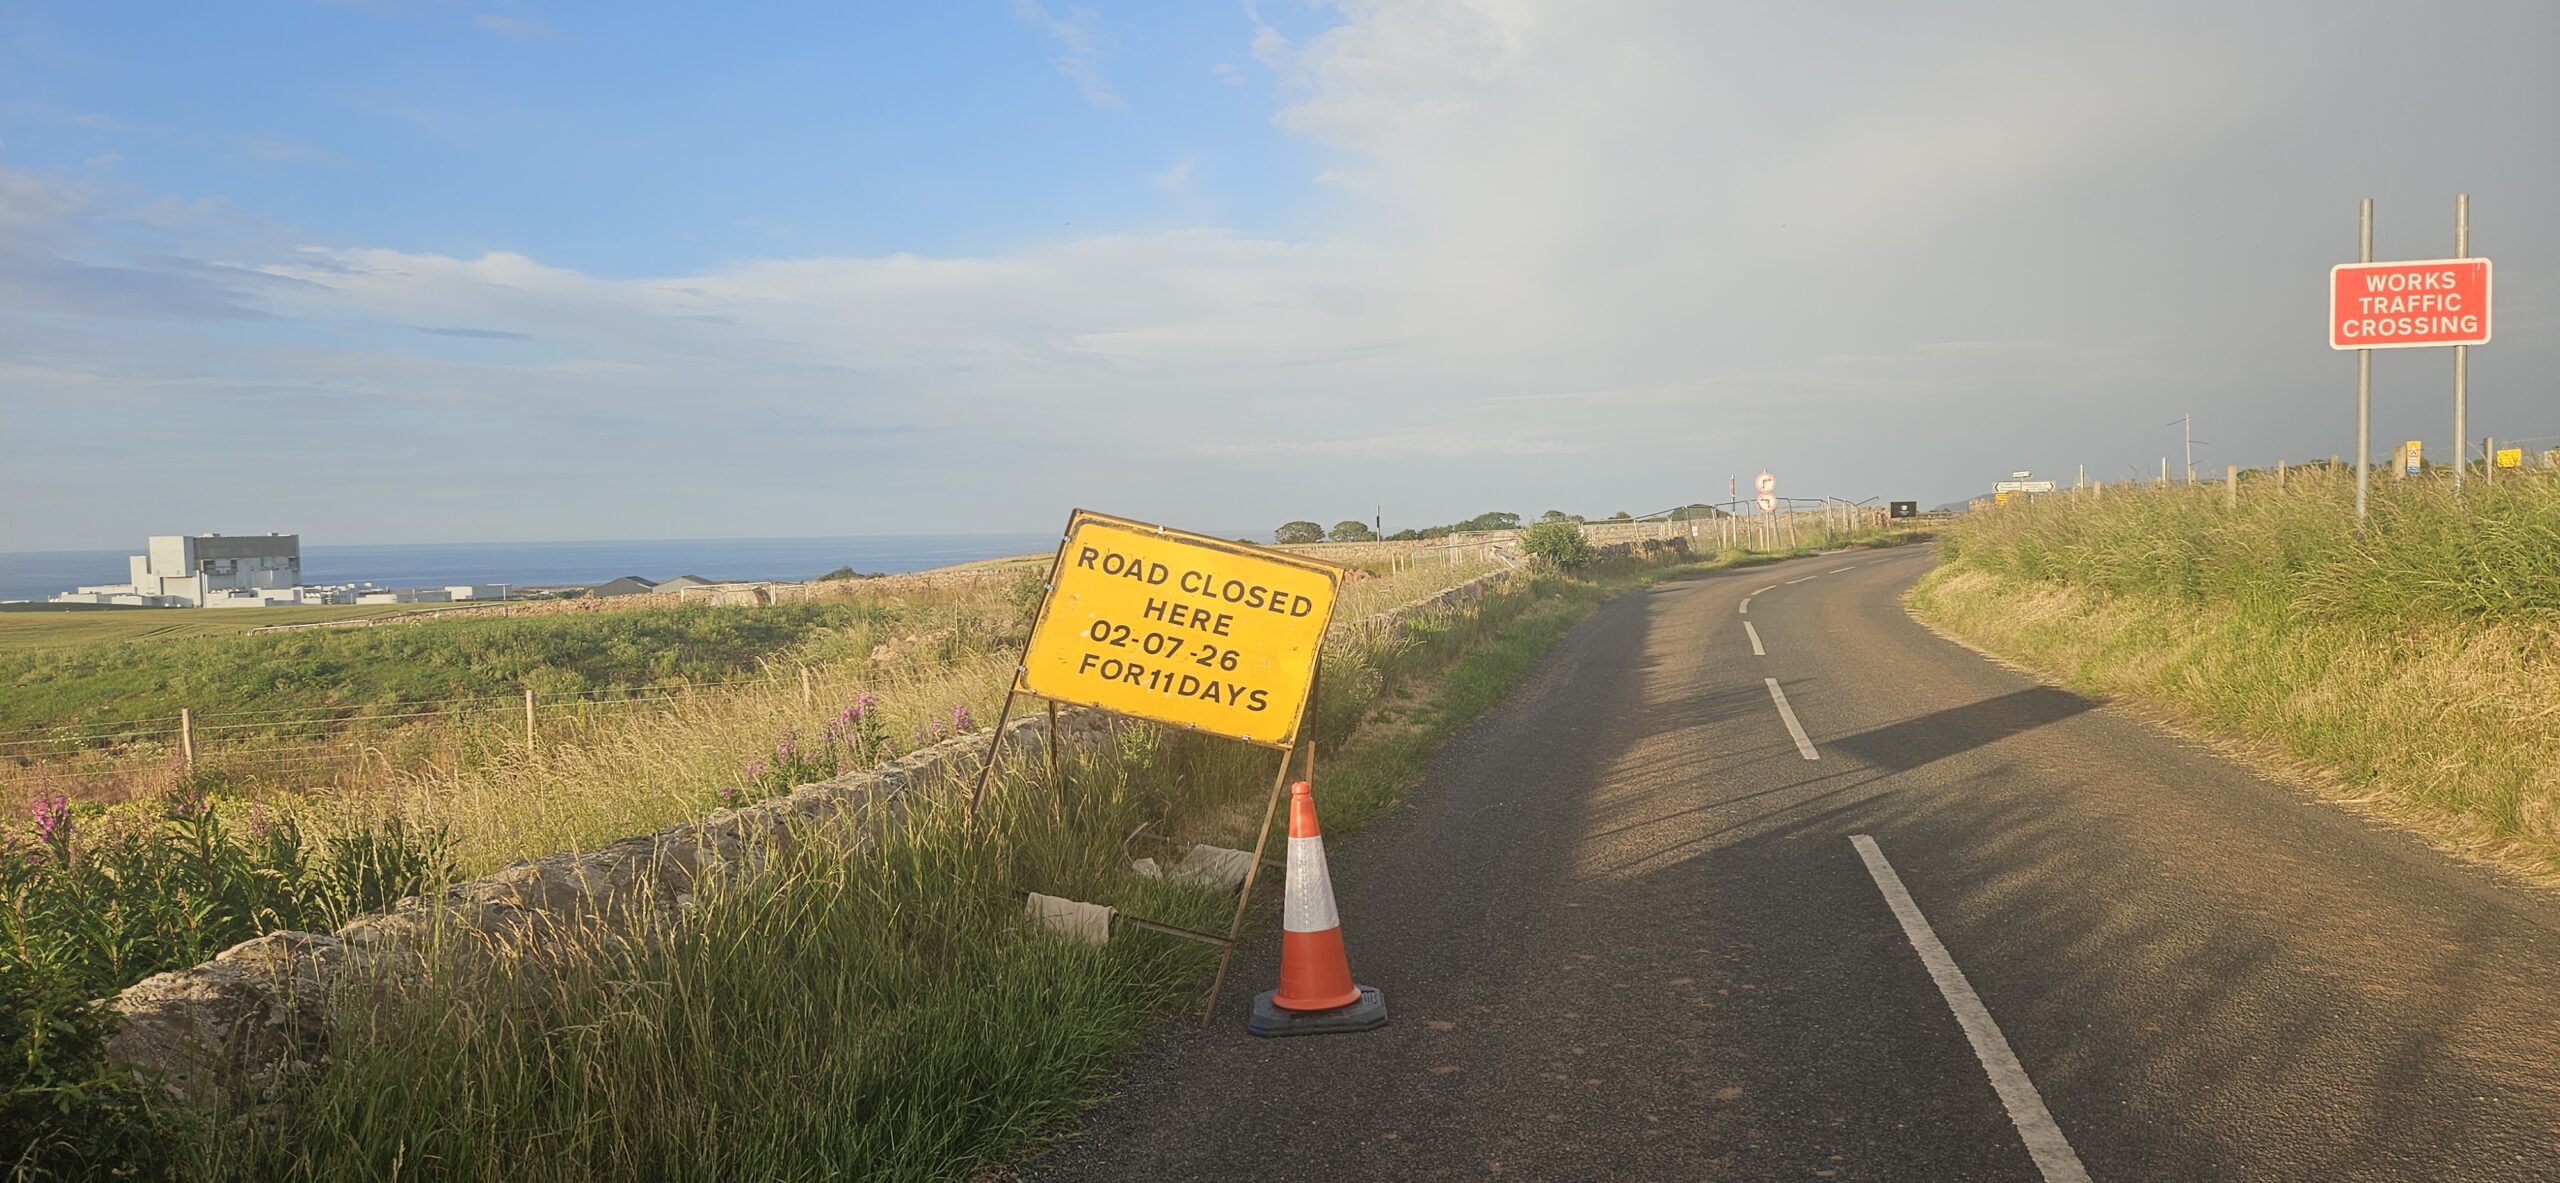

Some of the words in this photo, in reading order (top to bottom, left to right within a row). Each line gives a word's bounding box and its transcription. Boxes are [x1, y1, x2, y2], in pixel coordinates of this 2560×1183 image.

[2366, 271, 2456, 293] WORKS
[2358, 293, 2462, 315] TRAFFIC
[2342, 314, 2478, 338] CROSSING
[1077, 546, 1169, 586] ROAD
[1180, 570, 1313, 618] CLOSED
[1143, 597, 1234, 637] HERE
